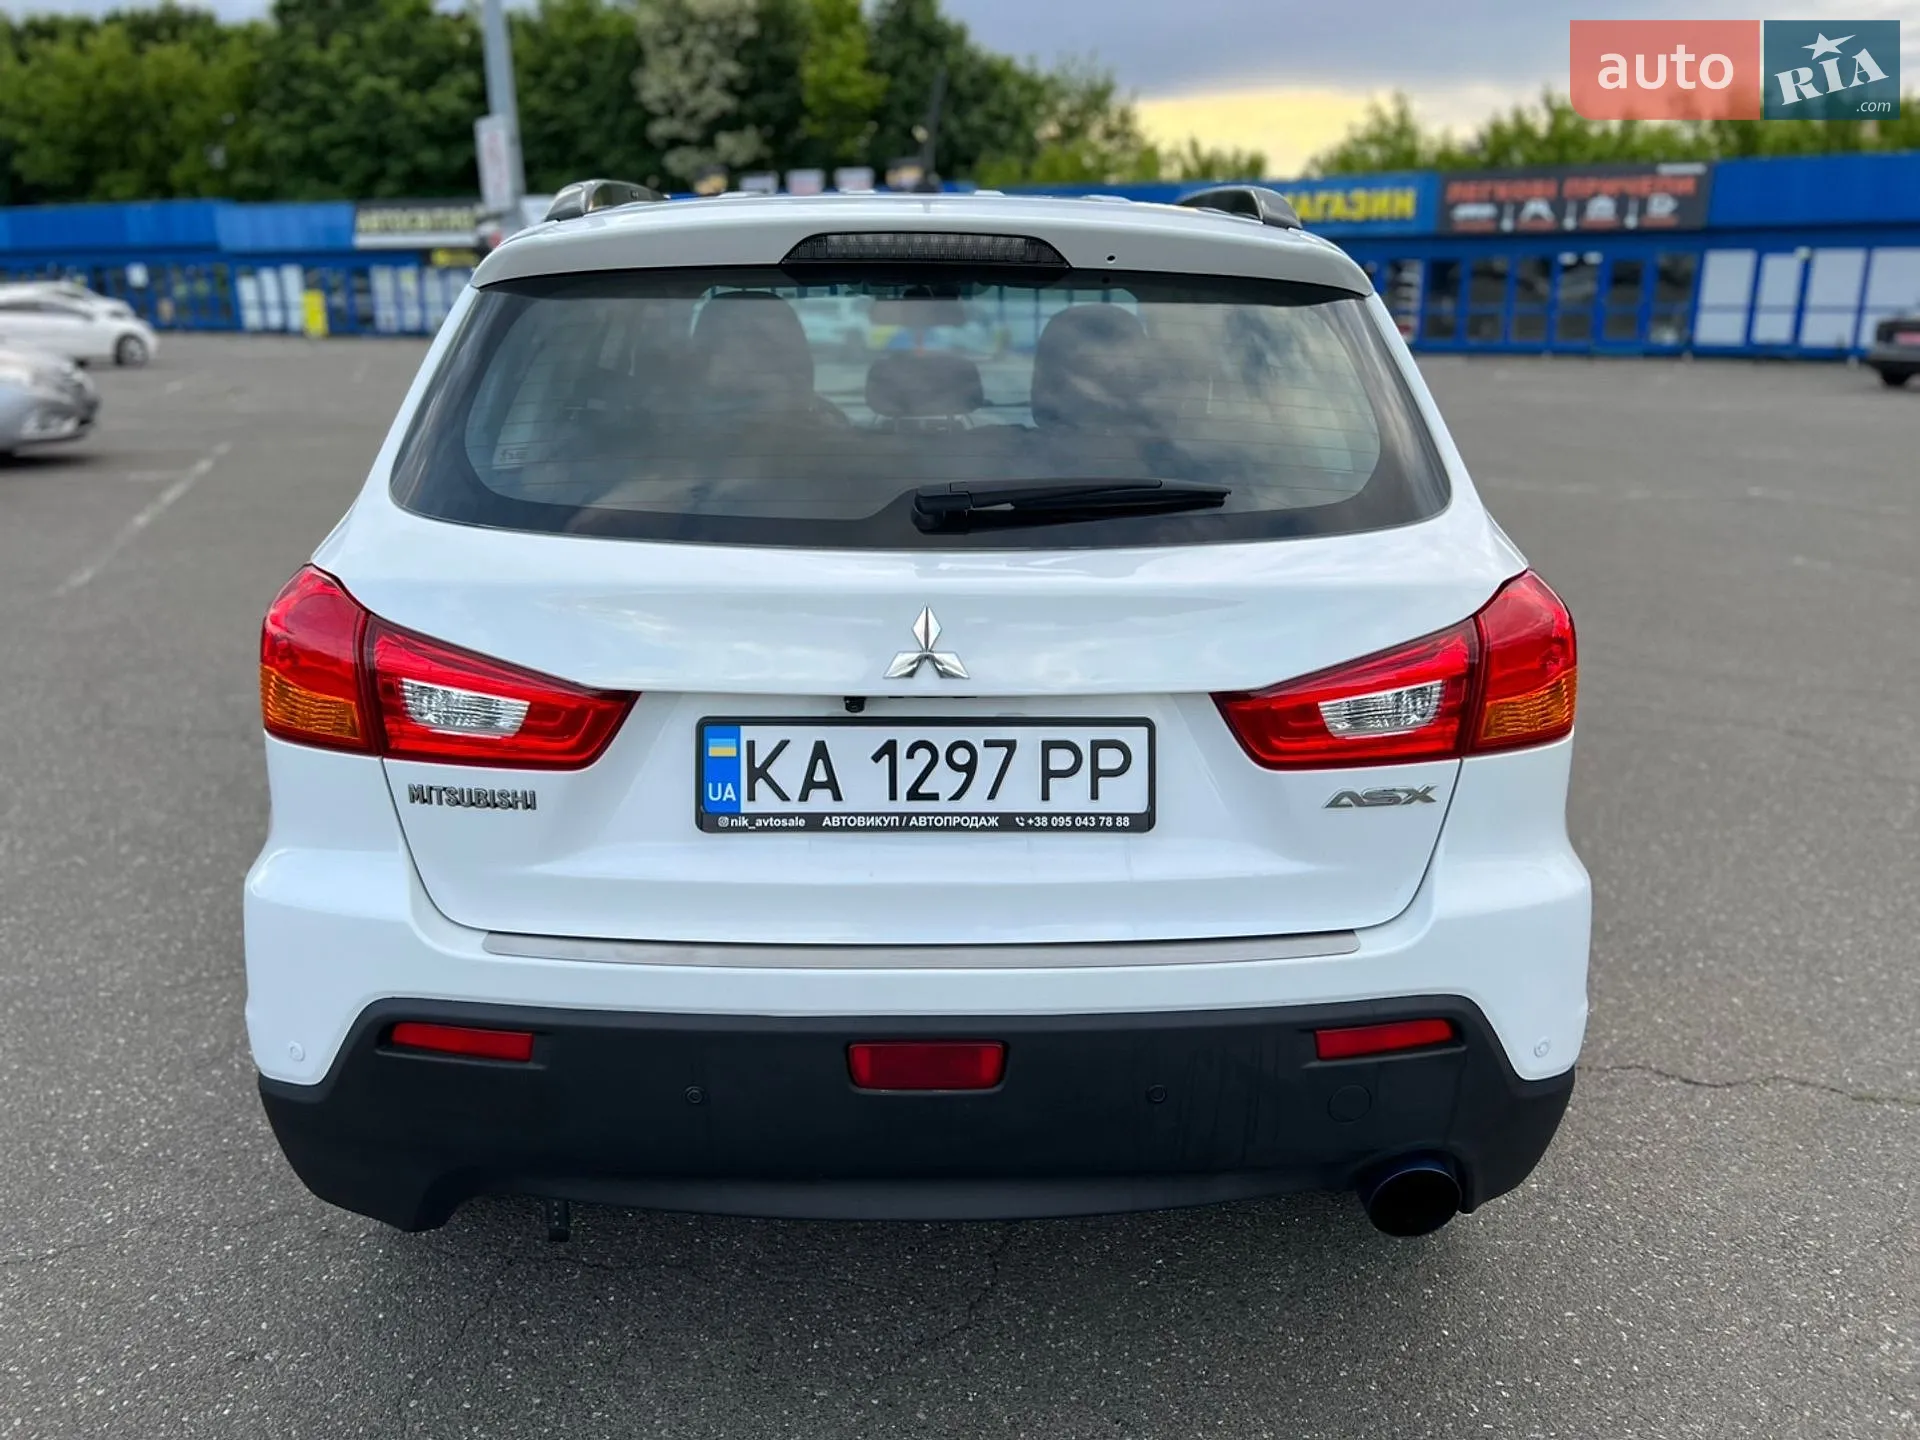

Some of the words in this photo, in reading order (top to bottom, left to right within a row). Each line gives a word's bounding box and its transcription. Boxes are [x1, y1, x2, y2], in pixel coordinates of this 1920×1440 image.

[1284, 187, 1416, 222] АГАЗИН
[746, 739, 844, 802] KA
[870, 739, 1018, 802] 1297
[1040, 739, 1133, 802] PP
[407, 783, 538, 811] MITSUBISHI
[707, 782, 738, 801] UA
[1323, 784, 1438, 809] ASX
[822, 815, 899, 828] АВТОВИКУП
[909, 815, 999, 829] АВТОПРОДАЖ
[1027, 816, 1048, 828] +38
[1051, 816, 1072, 828] 095
[1075, 816, 1096, 828] 043
[1099, 816, 1113, 828] 78
[1116, 816, 1131, 828] 88
